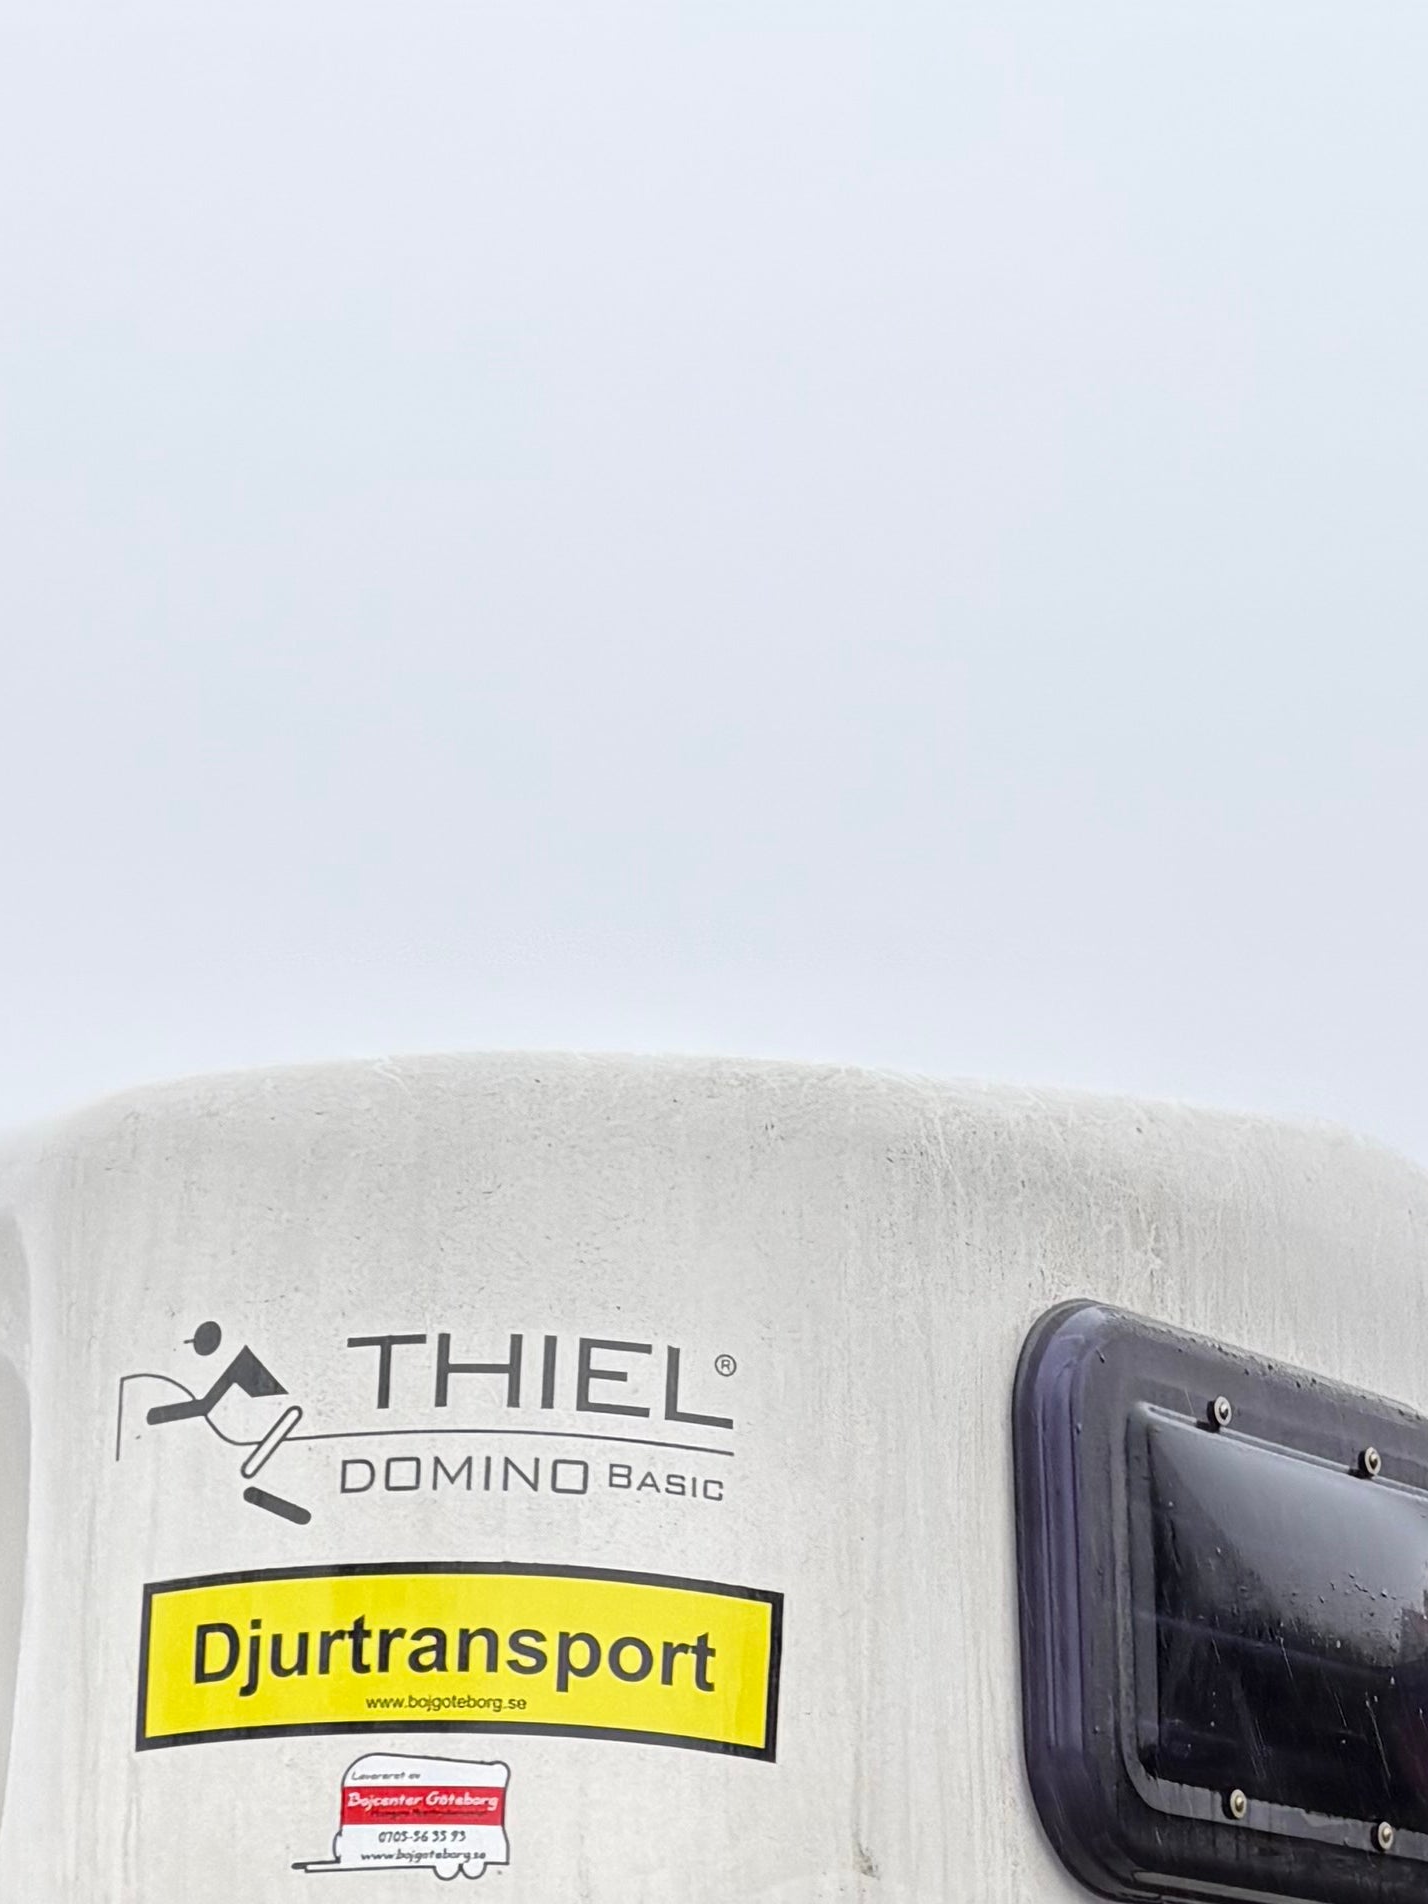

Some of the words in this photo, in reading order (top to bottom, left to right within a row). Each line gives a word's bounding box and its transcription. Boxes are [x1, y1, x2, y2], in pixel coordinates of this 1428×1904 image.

[340, 1455, 589, 1496] DOMINO
[193, 1615, 716, 1696] Djurtransport
[365, 1694, 528, 1713] www.bojgoteborg.se
